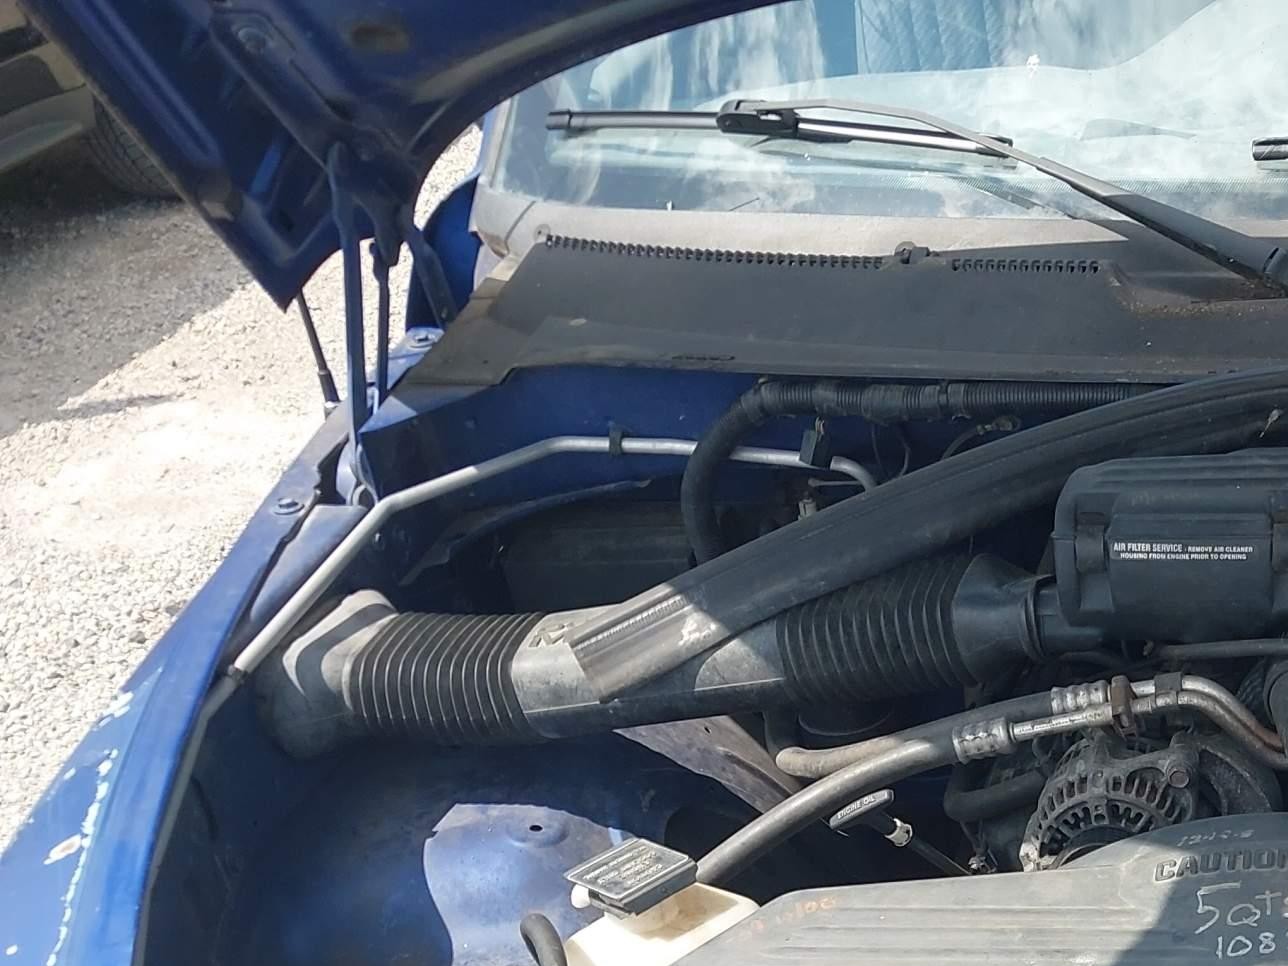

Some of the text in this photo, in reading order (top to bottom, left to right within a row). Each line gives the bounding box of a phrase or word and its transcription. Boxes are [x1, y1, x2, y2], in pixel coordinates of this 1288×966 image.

[1113, 542, 1126, 552] AIR
[1127, 542, 1151, 553] FILTER
[1152, 542, 1183, 553] SERVICE
